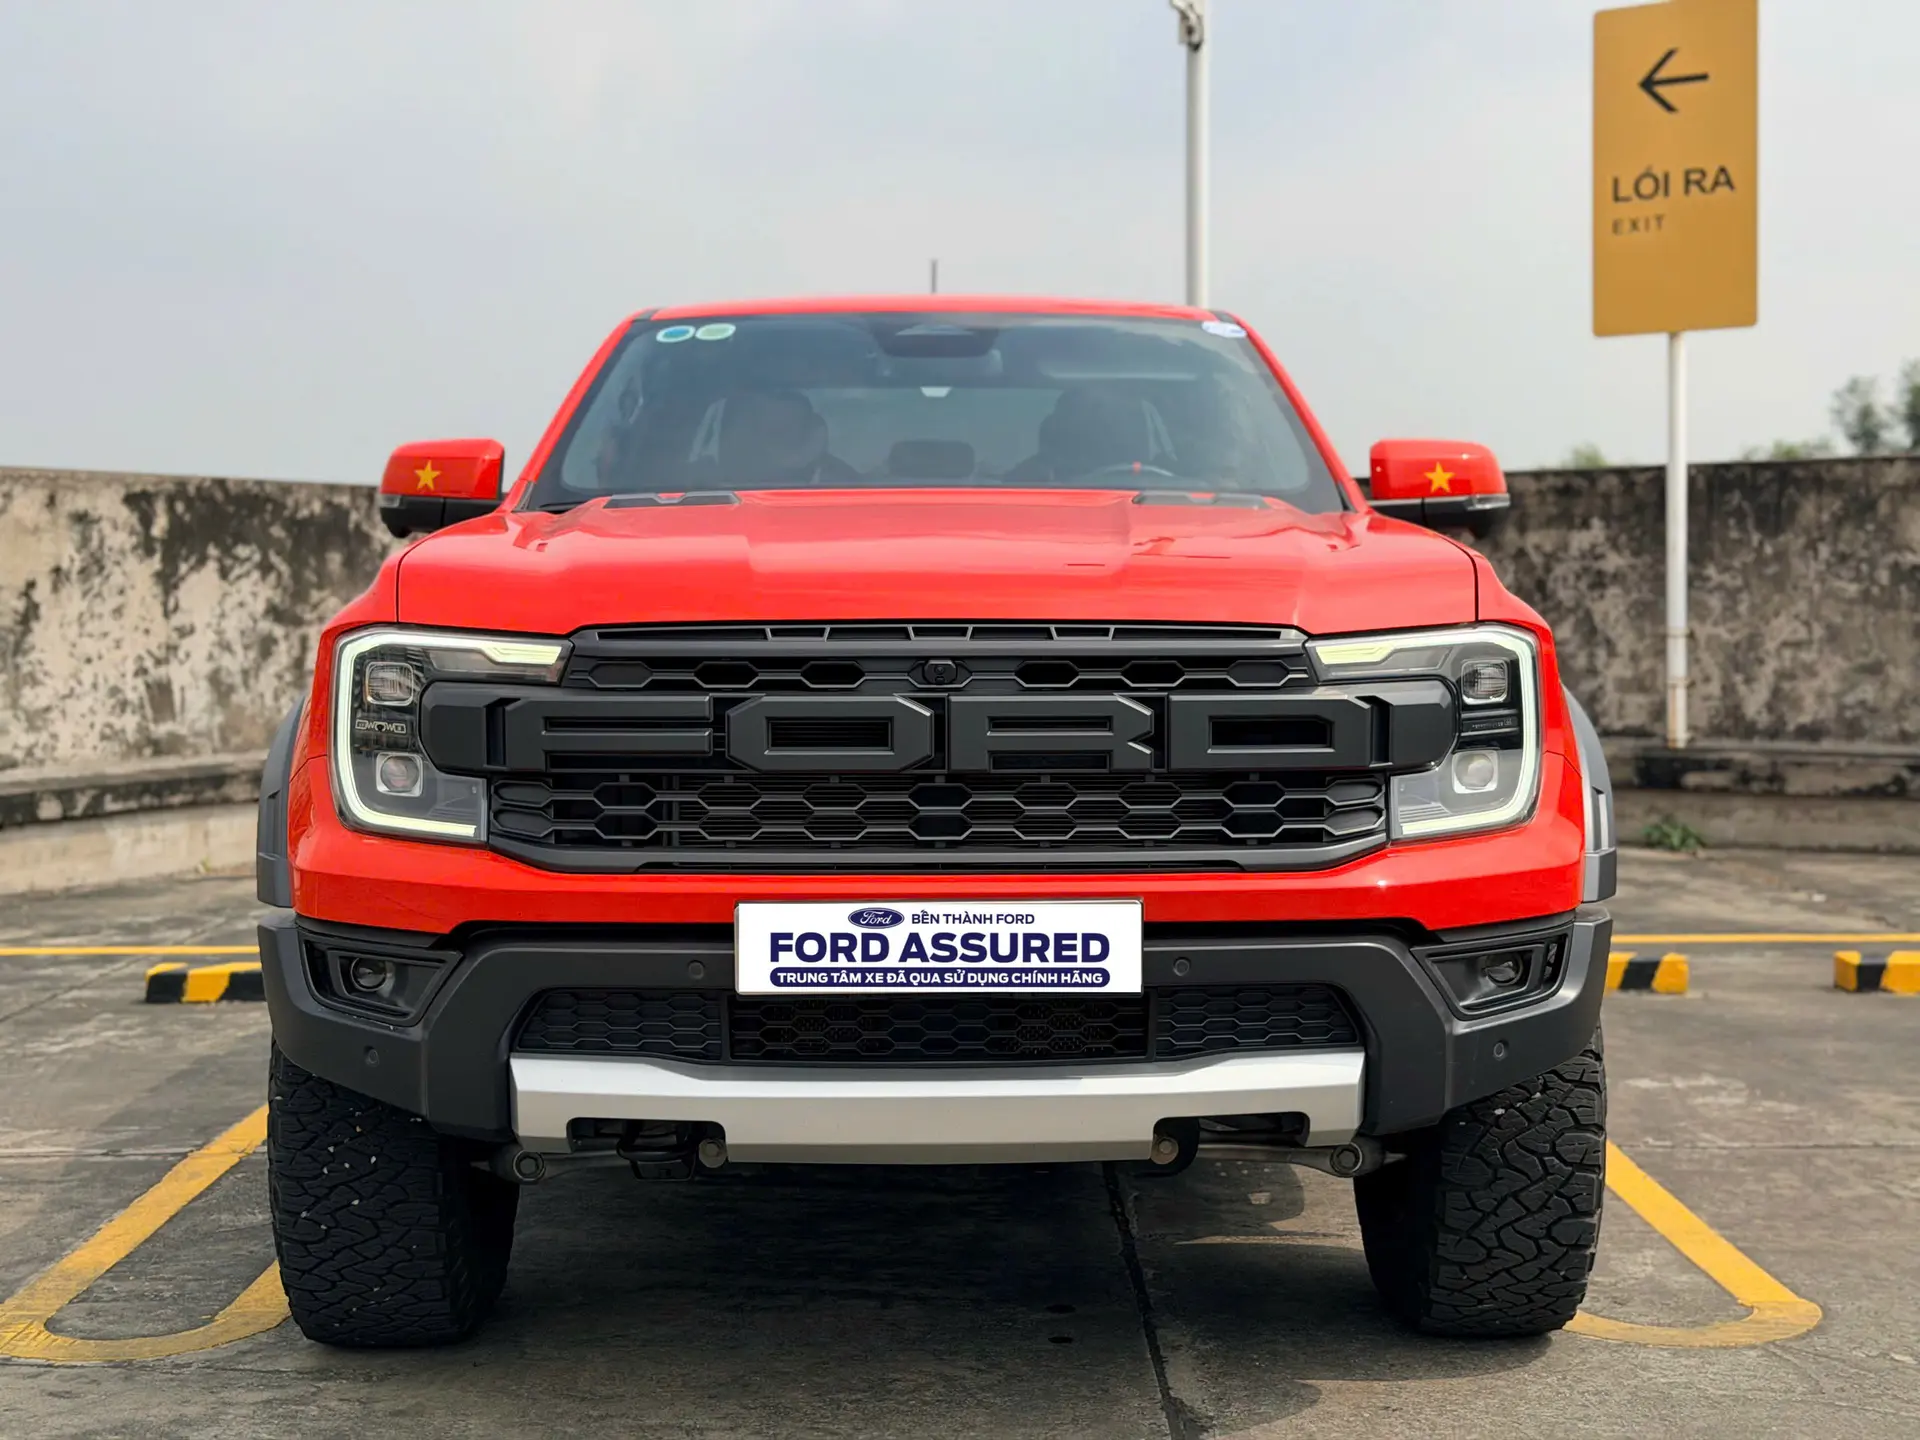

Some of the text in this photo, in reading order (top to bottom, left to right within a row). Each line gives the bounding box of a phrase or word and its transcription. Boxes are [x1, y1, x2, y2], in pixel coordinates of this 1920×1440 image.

[1683, 165, 1736, 197] RA
[1612, 213, 1666, 236] EXIT
[504, 694, 1372, 773] FORD
[943, 911, 993, 925] THÀNH
[996, 914, 1035, 925] FORD
[770, 932, 1111, 963] FORD ASSURED
[777, 969, 1103, 986] TRUNG TÂM XE ĐÃ QUA SỬ DỤNG CHÍNH HÃNG
